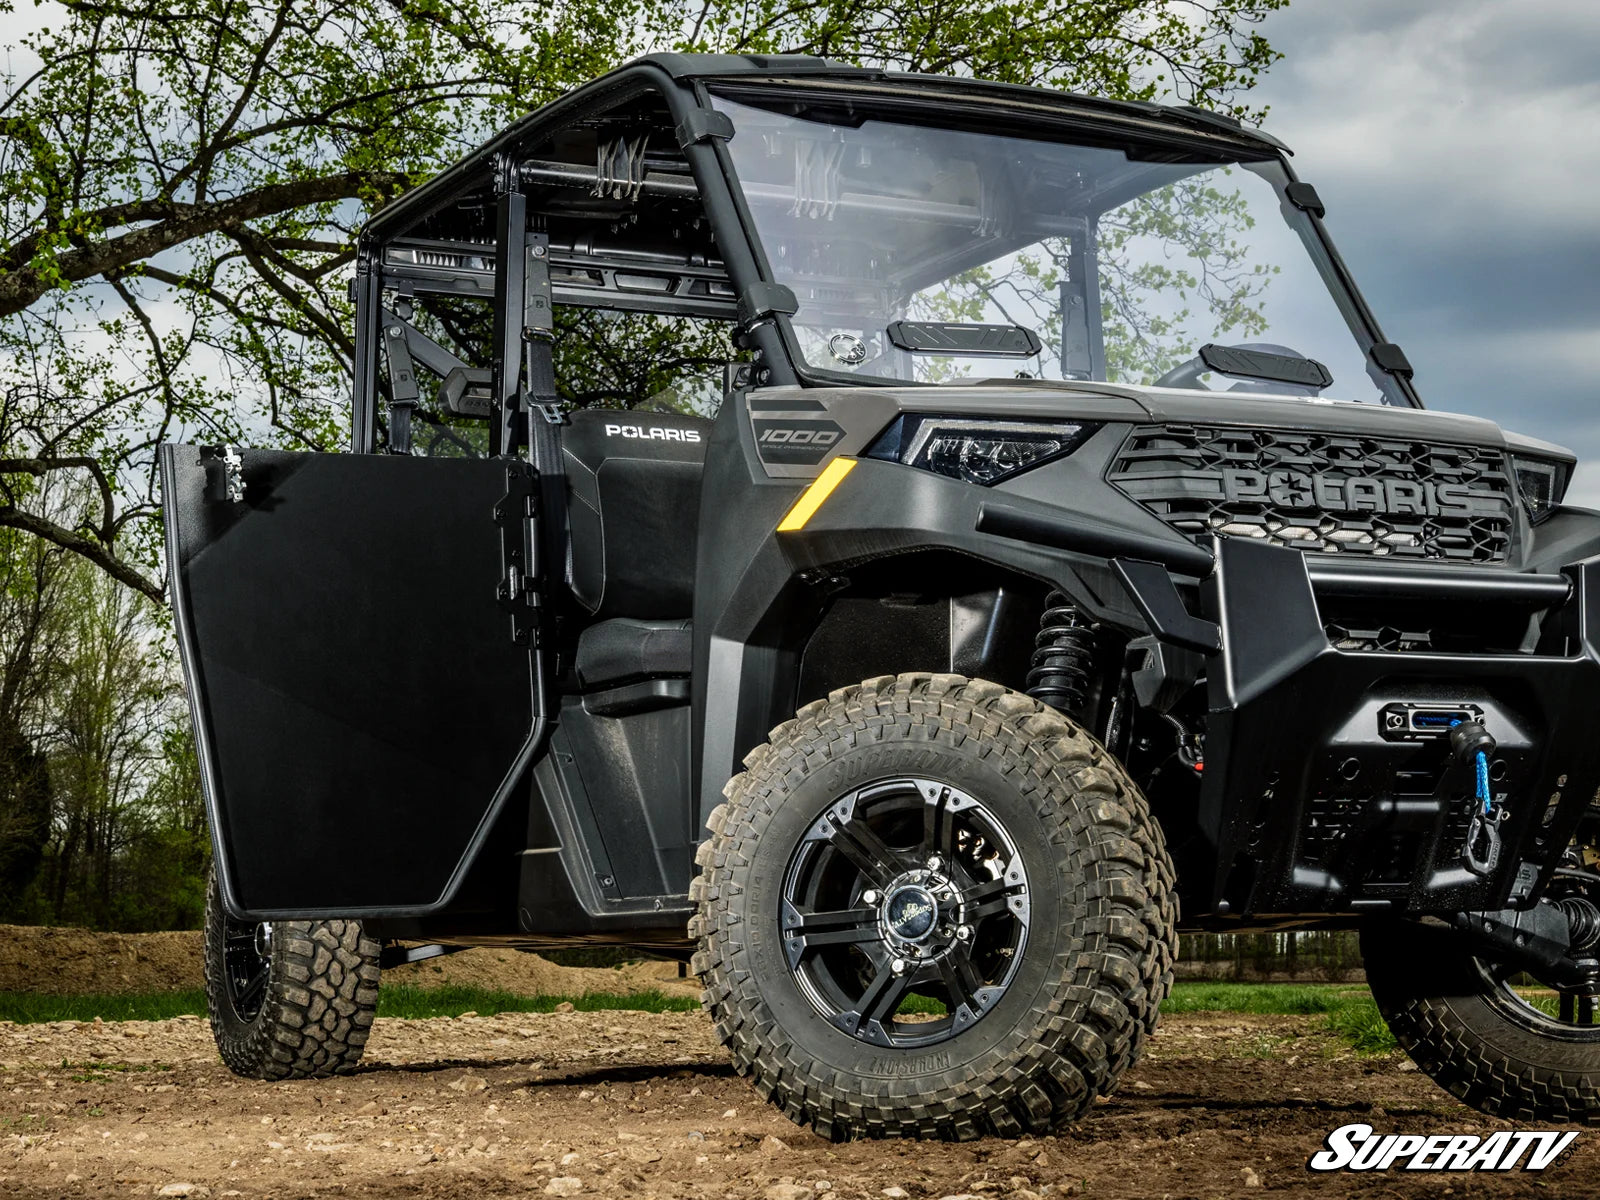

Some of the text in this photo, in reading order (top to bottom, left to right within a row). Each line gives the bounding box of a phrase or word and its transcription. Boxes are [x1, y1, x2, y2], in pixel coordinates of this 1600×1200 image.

[605, 424, 701, 443] POLARIS
[759, 428, 840, 444] 1000
[1222, 468, 1474, 518] POLARIS
